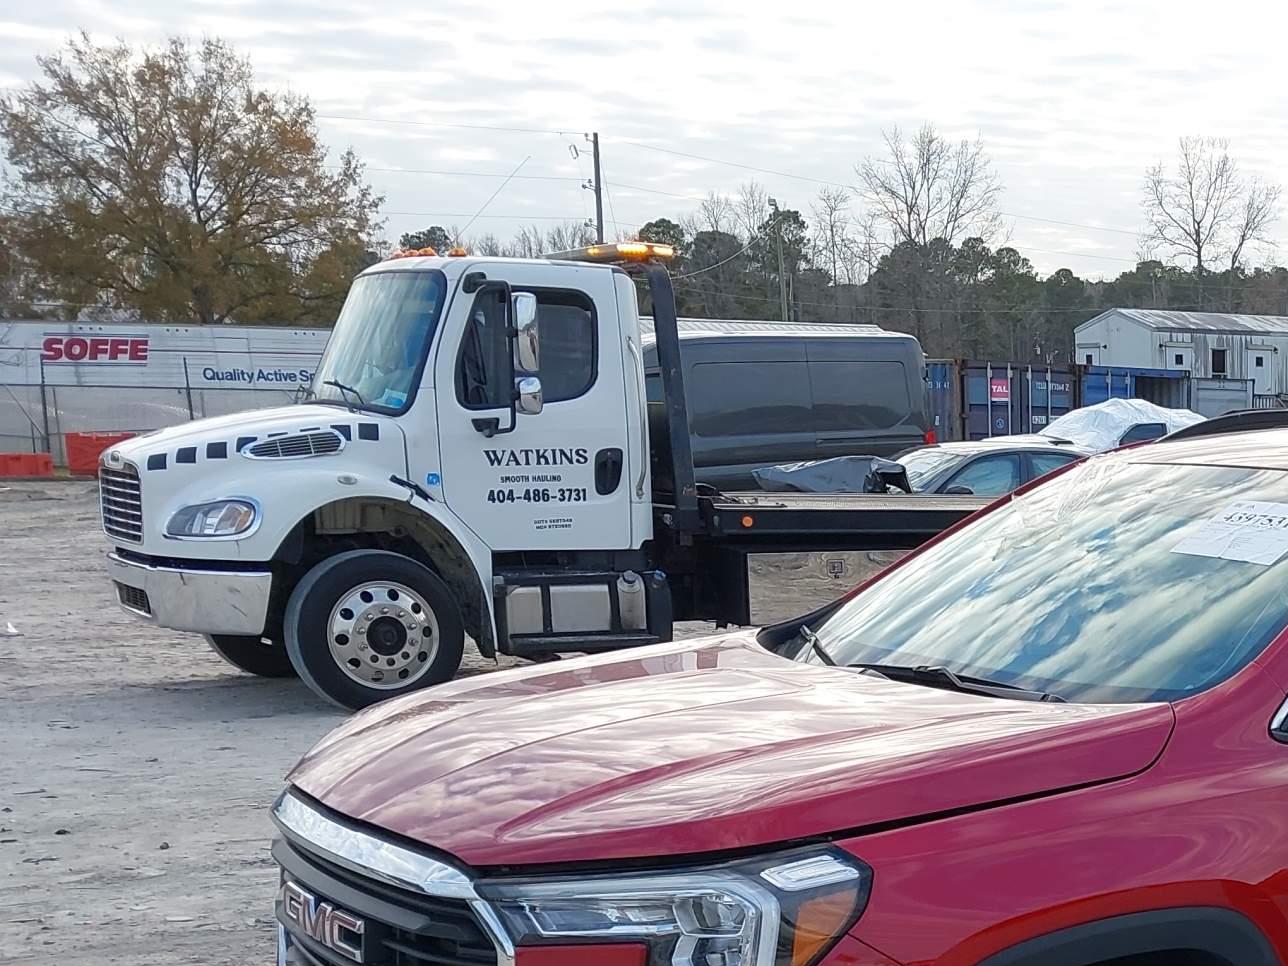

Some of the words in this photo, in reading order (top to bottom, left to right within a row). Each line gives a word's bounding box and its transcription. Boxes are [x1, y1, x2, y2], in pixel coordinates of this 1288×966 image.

[43, 337, 149, 361] SOFFE
[202, 367, 255, 384] Quality
[256, 367, 297, 383] Active
[991, 385, 1009, 393] TAL
[483, 448, 589, 467] WATKINS
[500, 475, 530, 484] SMOOTH
[532, 474, 562, 483] HAULING
[487, 488, 587, 504] 404-486-3731
[283, 881, 365, 963] GMC
